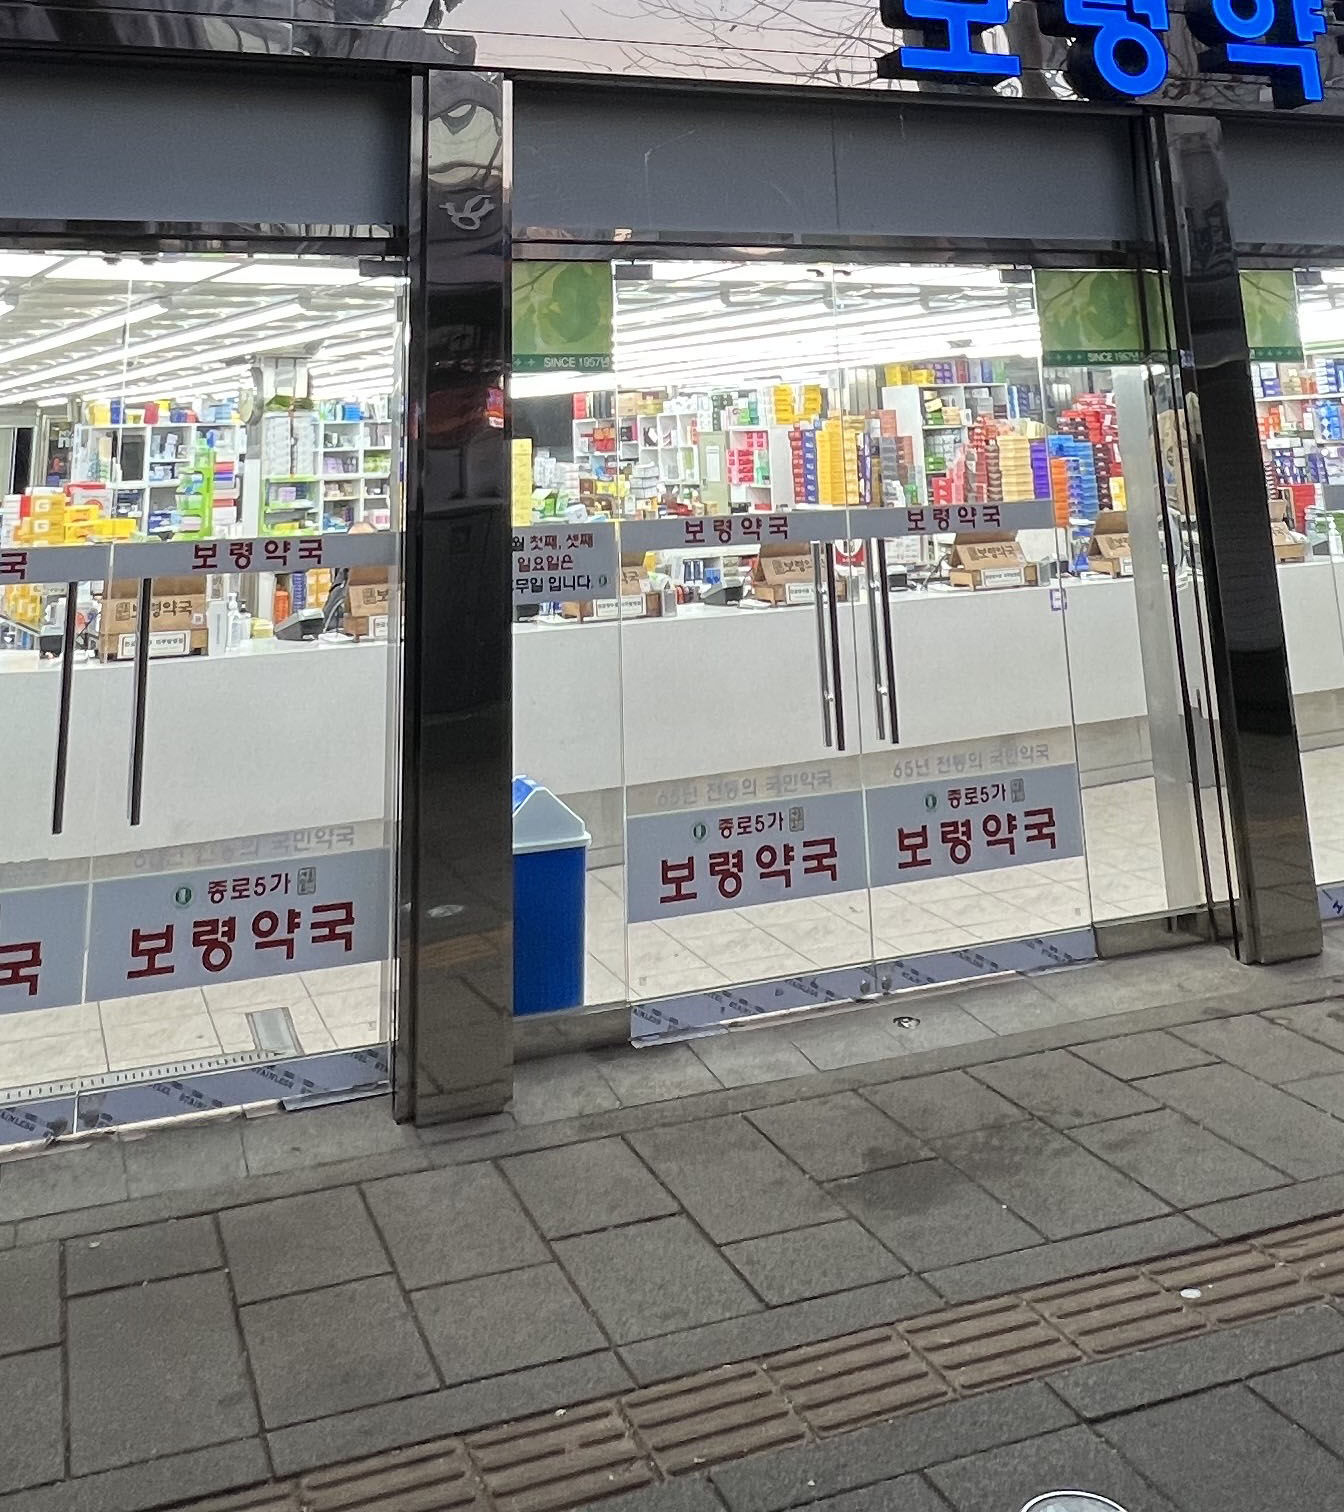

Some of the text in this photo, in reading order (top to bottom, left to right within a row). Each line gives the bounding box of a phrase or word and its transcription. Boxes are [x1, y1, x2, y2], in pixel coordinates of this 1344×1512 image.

[543, 356, 576, 368] SINCE
[684, 516, 790, 544] 보령약국
[907, 506, 1002, 533] 보령약국
[566, 532, 594, 548] 셋째
[192, 539, 323, 570] 보령약국
[517, 554, 574, 573] 일요일은
[512, 577, 544, 594] 무일
[947, 783, 1008, 809] 종로5가
[718, 811, 784, 840] 종로5가
[896, 807, 1056, 871] 보령약국
[659, 836, 839, 904] 보령약국
[208, 872, 292, 905] 종로5가
[127, 900, 356, 980] 보령약국
